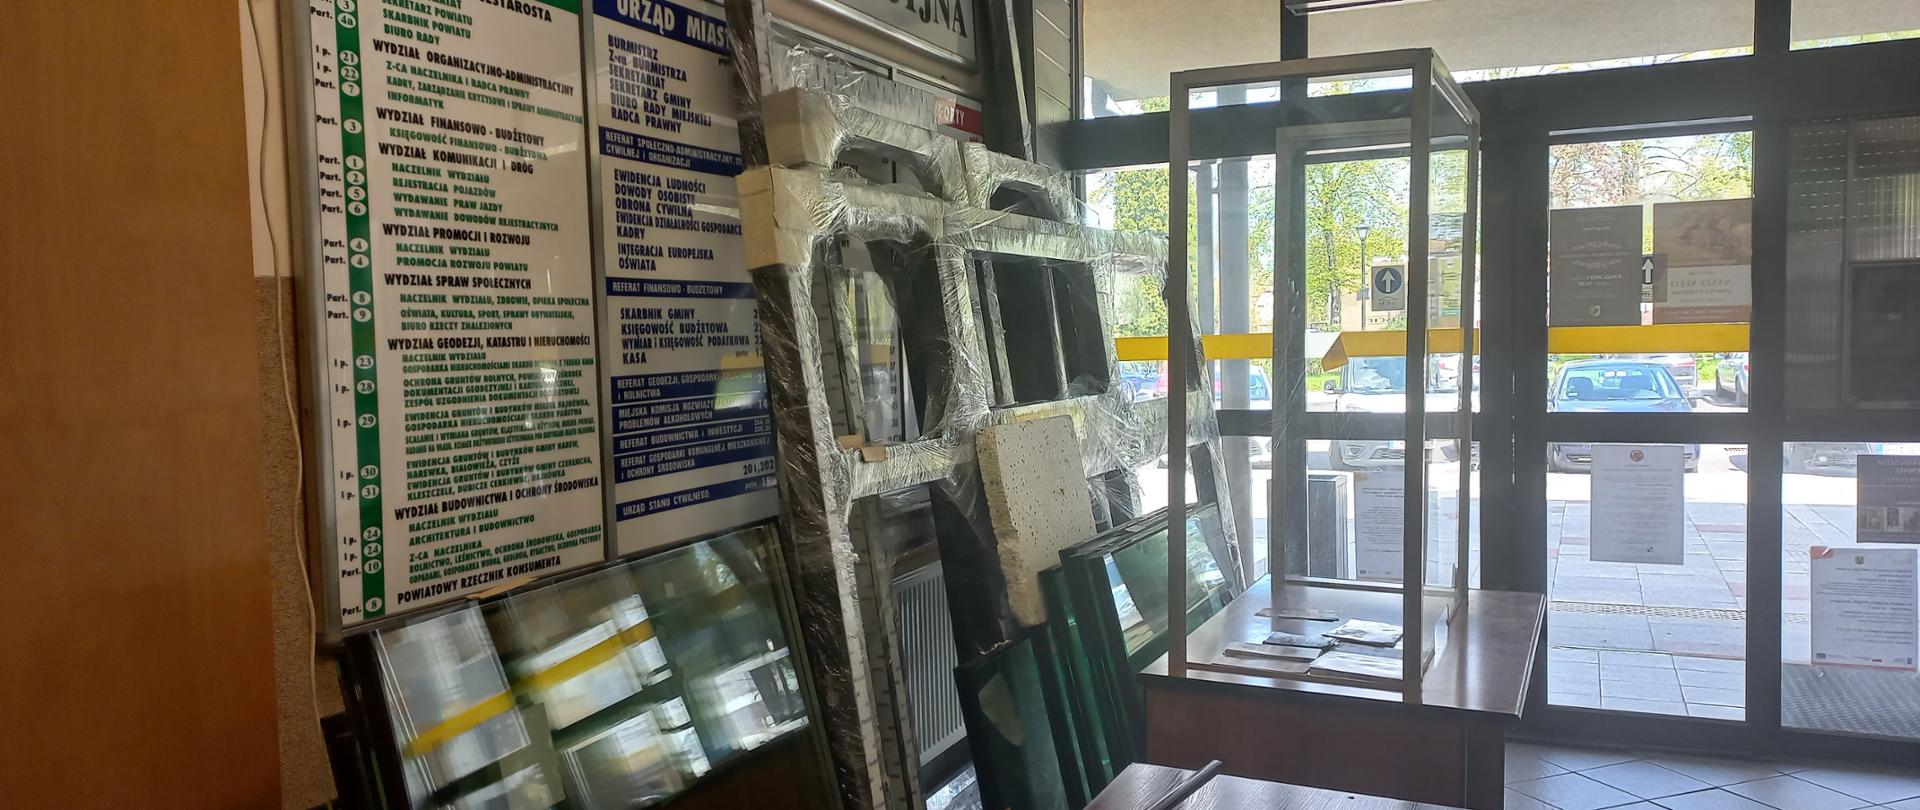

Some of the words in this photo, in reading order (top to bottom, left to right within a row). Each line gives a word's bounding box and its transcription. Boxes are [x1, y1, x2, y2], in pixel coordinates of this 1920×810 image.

[310, 6, 333, 19] Part.
[341, 15, 354, 26] 4a
[617, 0, 675, 34] URZĄD
[383, 9, 429, 29] SKARBNIK
[432, 21, 471, 39] POWIATU
[384, 24, 413, 39] BIURO
[416, 31, 440, 45] RADY
[608, 34, 658, 61] BURMISTRZ
[343, 52, 354, 63] 21
[344, 68, 357, 79] 22
[373, 40, 420, 60] WYDZIAŁ
[427, 52, 573, 95] ORGANIZACYJNO-ADMINISTRACYJNY
[633, 57, 687, 82] BURMISTRZA
[315, 78, 335, 89] Part.
[386, 61, 408, 73] Z-CA
[411, 66, 463, 84] NACZELNIKA
[471, 79, 497, 92] RADCA
[499, 85, 529, 99] PRAWNY
[387, 76, 415, 90] KADRY,
[609, 64, 665, 89] SEKRETARIAT
[388, 91, 444, 109] INFORMATYK
[610, 78, 658, 101] SEKRETARZ
[664, 92, 691, 109] GMINY
[611, 92, 638, 110] BIURO
[644, 101, 666, 117] RADY
[672, 108, 712, 127] MIEJSKIEJ
[316, 115, 338, 126] Part.
[377, 108, 424, 125] WYDZIAŁ
[431, 116, 486, 136] FINANSOWO
[496, 128, 544, 146] BUDŻETOWY
[611, 107, 640, 124] RADCA
[645, 115, 682, 133] PRAWNY
[390, 128, 447, 144] KSIĘGOWOŚĆ
[450, 137, 497, 152] FINANSOWO
[606, 131, 634, 146] REFERAT
[379, 143, 426, 159] WYDZIAŁ
[433, 150, 497, 169] KOMUNIKACJI
[511, 161, 534, 174] DRÓG
[606, 143, 640, 159] CYWILNEJ
[319, 155, 340, 165] Part.
[320, 172, 341, 182] Part.
[392, 163, 441, 177] NACZELNIK
[448, 170, 490, 184] WYDZIAŁU
[393, 178, 448, 192] REJESTRACJA
[454, 185, 496, 198] POJAZDÓW
[614, 169, 662, 188] EWIDENCJA
[667, 178, 706, 194] LUDNOŚCI
[321, 188, 342, 198] Part.
[615, 183, 652, 199] DOWODY
[322, 204, 343, 214] Part.
[394, 193, 448, 206] WYDAWANIE
[454, 199, 477, 209] PRAW
[480, 202, 503, 212] JAZDY
[616, 198, 651, 213] OBRONA
[394, 208, 448, 221] WYDAWANIE
[454, 213, 496, 225] DOWODÓW
[616, 211, 654, 227] EWIDENCJA
[383, 224, 430, 238] WYDZIAŁ
[433, 228, 481, 242] PROMOCJI
[490, 232, 530, 246] ROZWOJU
[617, 226, 645, 239] KADRY
[324, 239, 345, 248] Part.
[396, 243, 444, 254] NACZELNIK
[450, 246, 490, 257] WYDZIAŁU
[618, 243, 664, 257] INTEGRACJA
[668, 247, 714, 260] EUROPEJSKA
[325, 256, 346, 264] Part.
[397, 257, 448, 268] PROMOCJA
[450, 260, 491, 270] ROZWOJU
[493, 262, 528, 271] POWIATU
[619, 256, 656, 271] OŚWIATA
[385, 274, 433, 286] WYDZIAŁ
[436, 276, 469, 287] SPRAW
[473, 277, 531, 289] SPOŁECZNYCH
[613, 282, 640, 292] REFERAT
[644, 283, 682, 294] FINANSOWO
[327, 294, 348, 302] Part.
[400, 294, 447, 303] NACZELNIK
[328, 311, 349, 319] Part.
[401, 308, 438, 319] OŚWIATA,
[441, 310, 476, 319] KULTURA,
[621, 308, 662, 320] SKARBNIK
[668, 308, 695, 320] GMINY
[401, 322, 427, 331] BIURO
[430, 322, 458, 330] RZECZY
[461, 322, 513, 330] ZNALEZIONYCH
[621, 321, 674, 336] KSIĘGOWOŚĆ
[680, 320, 728, 335] BUDŻETOWA
[388, 338, 434, 350] WYDZIAŁ
[437, 337, 484, 350] GEODEZJI,
[486, 337, 526, 348] KATASTRU
[534, 334, 590, 346] NIERUCHOMOŚCI
[622, 337, 652, 350] WYMIAR
[708, 336, 750, 347] PODATKOWA
[360, 358, 371, 367] 23
[402, 354, 446, 363] NACZELNIK
[449, 352, 486, 361] WYDZIAŁU
[623, 352, 647, 364] KASA
[361, 382, 373, 392] 28
[403, 378, 442, 387] OCHRONA
[445, 376, 482, 385] GRUNTÓW
[617, 378, 645, 389] REFERAT
[404, 387, 463, 397] DOKUMENTACJI
[405, 397, 433, 408] ZESPÓŁ
[436, 395, 486, 405] UZGODNIENIA
[405, 411, 449, 422] EWIDENCJA
[452, 407, 488, 418] GRUNTÓW
[619, 407, 648, 418] MIEJSKA
[362, 416, 374, 426] 29
[405, 420, 458, 432] GOSPODARKA
[620, 437, 648, 449] REFERAT
[407, 457, 451, 469] EWIDENCJA
[453, 452, 489, 463] GRUNTÓW
[496, 446, 534, 458] BUDYNKÓW
[364, 468, 376, 478] 30
[407, 467, 448, 479] NAREWKA,
[407, 477, 451, 490] EWIDENCJA
[454, 472, 490, 484] GRUNTÓW
[365, 487, 376, 497] 31
[395, 503, 438, 520] WYDZIAŁ
[442, 492, 507, 512] BUDOWNICTWA
[515, 484, 552, 500] OCHRONY
[554, 477, 599, 493] ŚRODOWISKA
[408, 487, 455, 501] KLESZCZELE,
[458, 482, 488, 493] DUBICZE
[409, 517, 456, 532] NACZELNIK
[458, 509, 499, 523] WYDZIAŁU
[410, 527, 471, 546] ARCHITEKTURA
[479, 515, 535, 533] BUDOWNICTWO
[410, 551, 429, 563] Z-CA
[434, 541, 482, 557] NACZELNIKA
[342, 565, 364, 578] Part.
[368, 562, 379, 572] 10
[410, 558, 453, 573] ROLNICTWO,
[398, 580, 458, 604] POWIATOWY
[461, 569, 504, 588] RZECZNIK
[507, 556, 561, 577] KONSUMENTA
[342, 606, 362, 616] Part.
